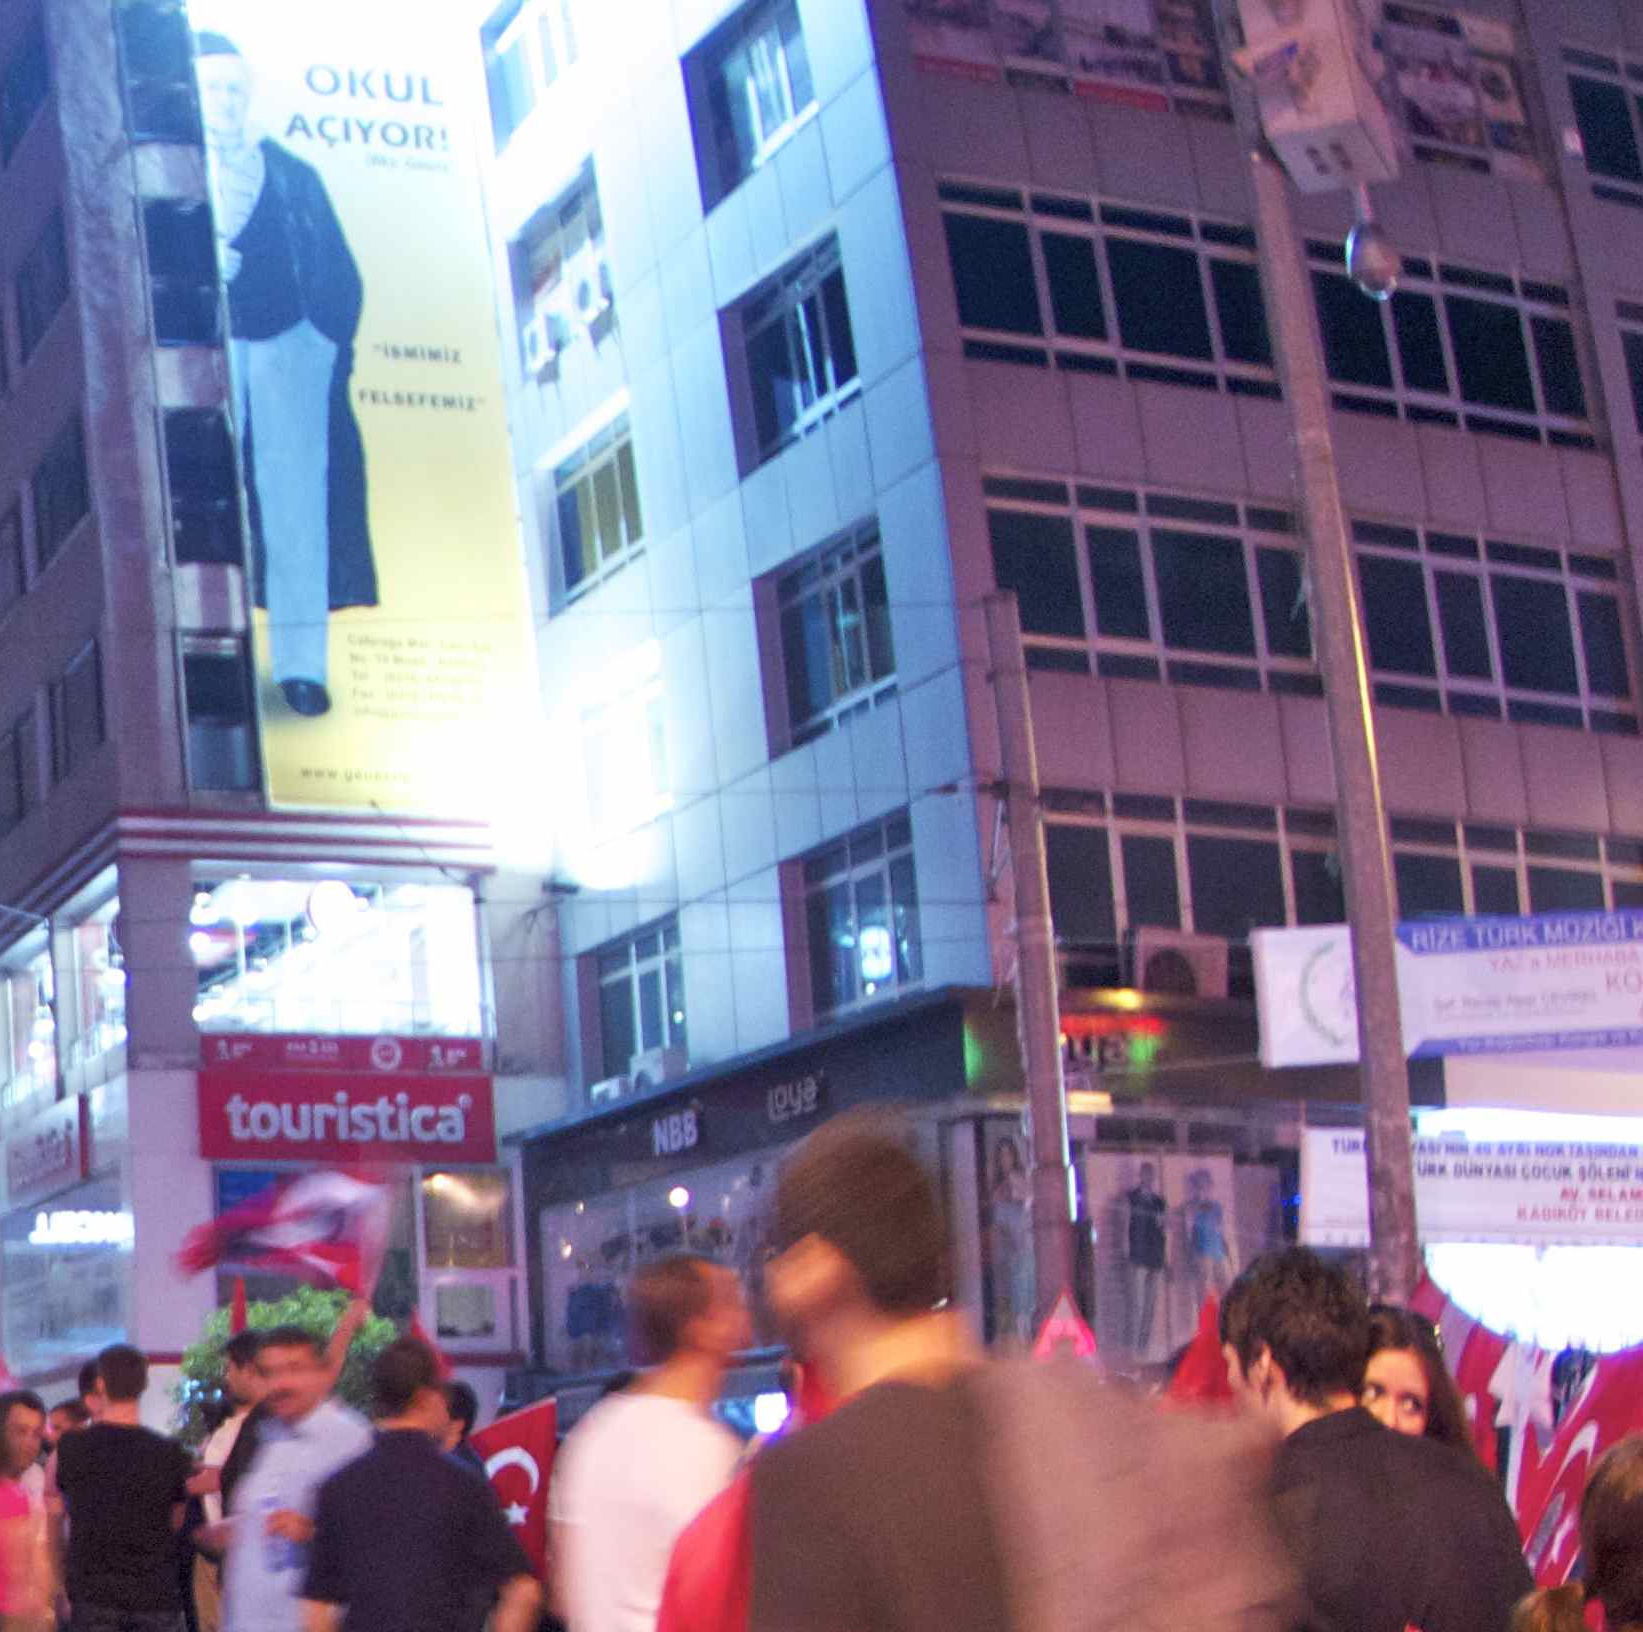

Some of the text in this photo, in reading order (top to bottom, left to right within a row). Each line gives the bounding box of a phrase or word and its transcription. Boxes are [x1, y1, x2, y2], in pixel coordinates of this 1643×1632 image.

[305, 64, 444, 106] OKUL
[285, 113, 449, 151] AÇIYOR!
[224, 1089, 468, 1143] touristica
